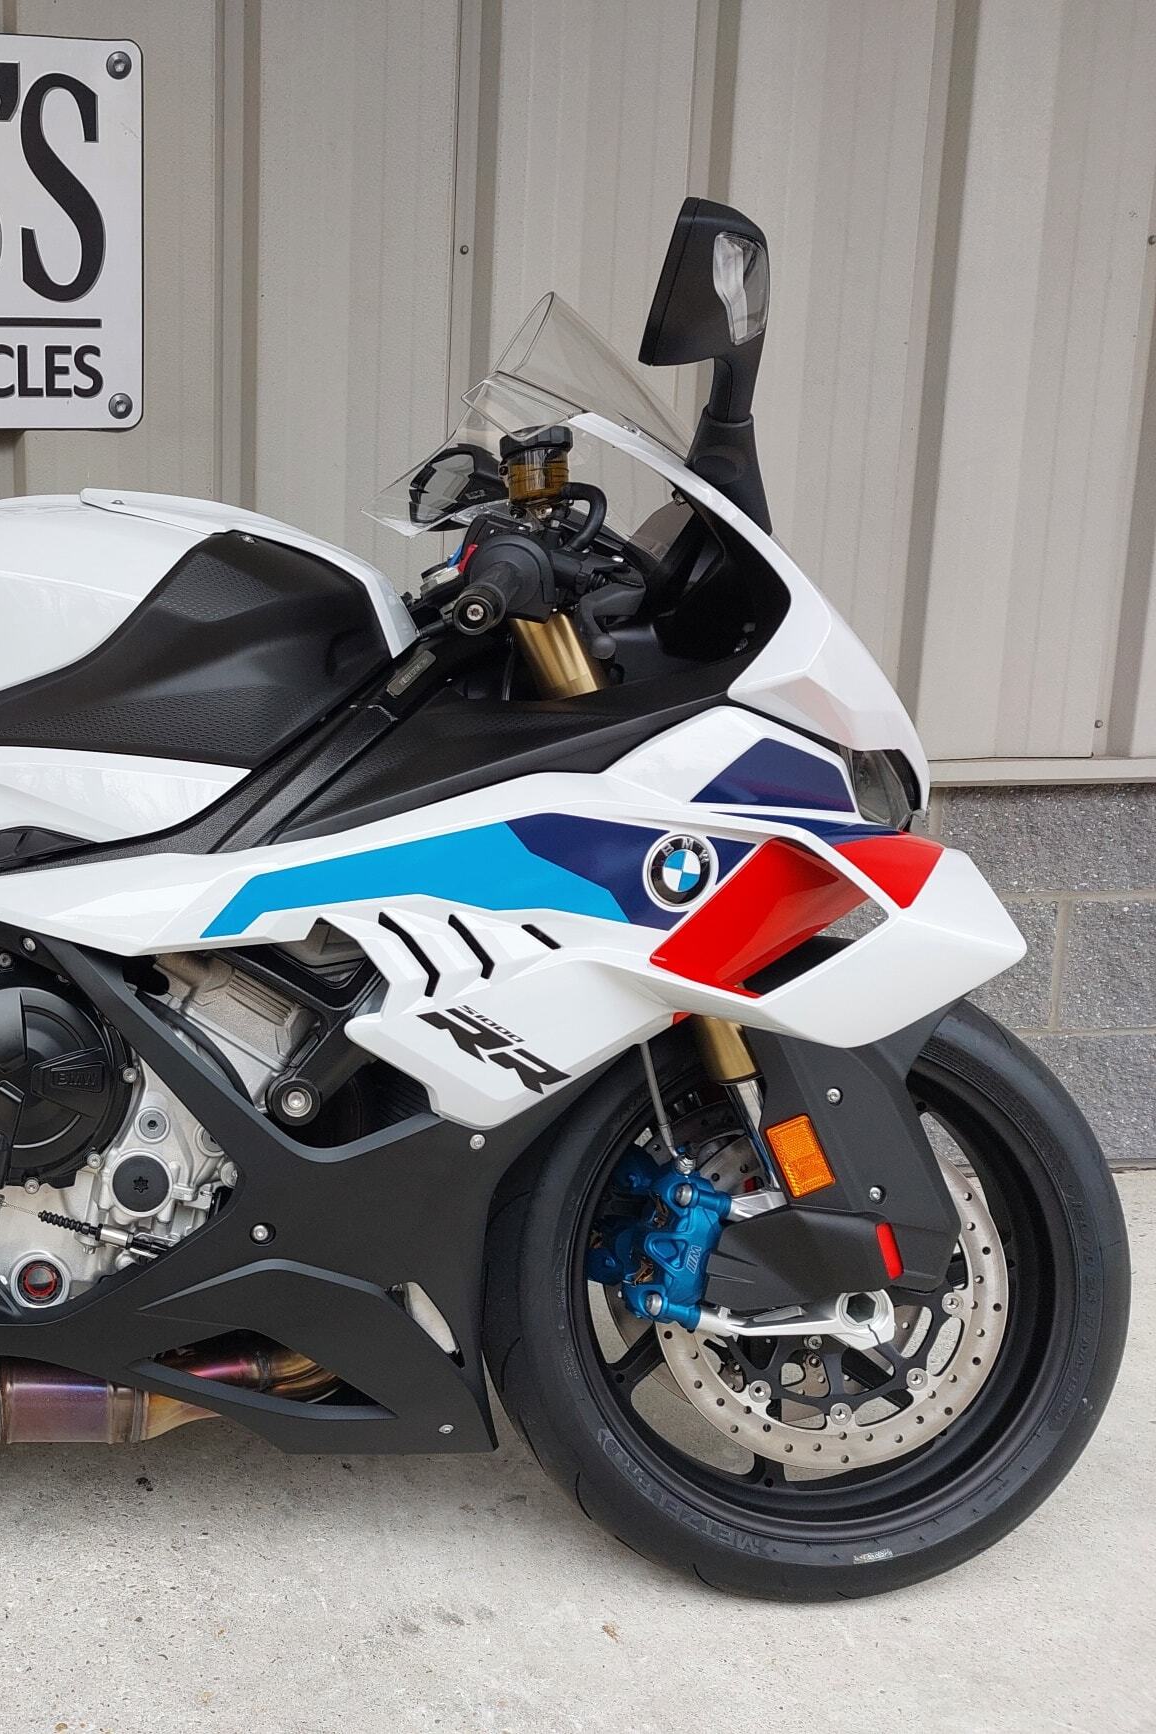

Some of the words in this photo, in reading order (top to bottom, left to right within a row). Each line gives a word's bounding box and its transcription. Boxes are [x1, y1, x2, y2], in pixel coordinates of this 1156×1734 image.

[660, 837, 710, 864] BMW
[415, 1007, 573, 1095] RR
[57, 1071, 97, 1087] BMW
